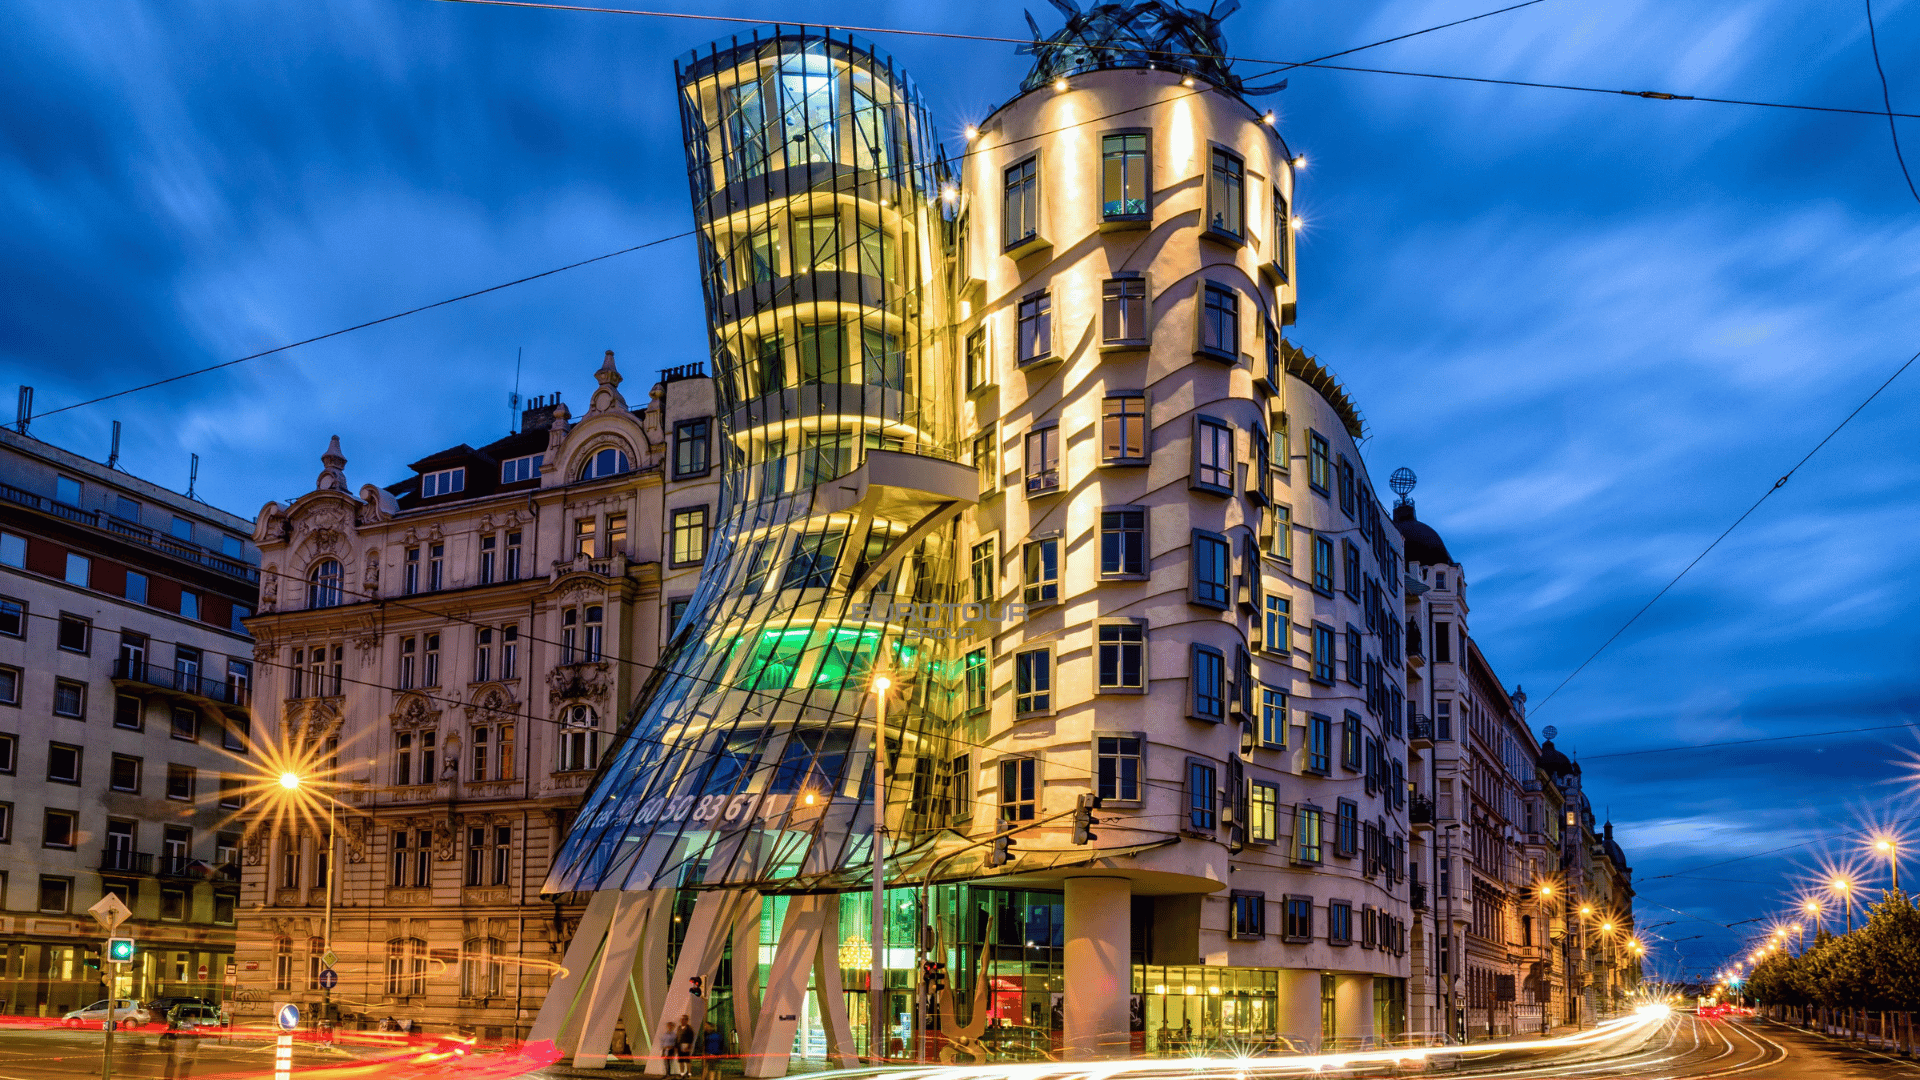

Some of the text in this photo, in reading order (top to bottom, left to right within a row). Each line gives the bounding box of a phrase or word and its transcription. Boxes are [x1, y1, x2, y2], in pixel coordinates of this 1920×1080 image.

[634, 797, 665, 824] 60
[660, 793, 696, 823] 50
[692, 793, 726, 822] 83
